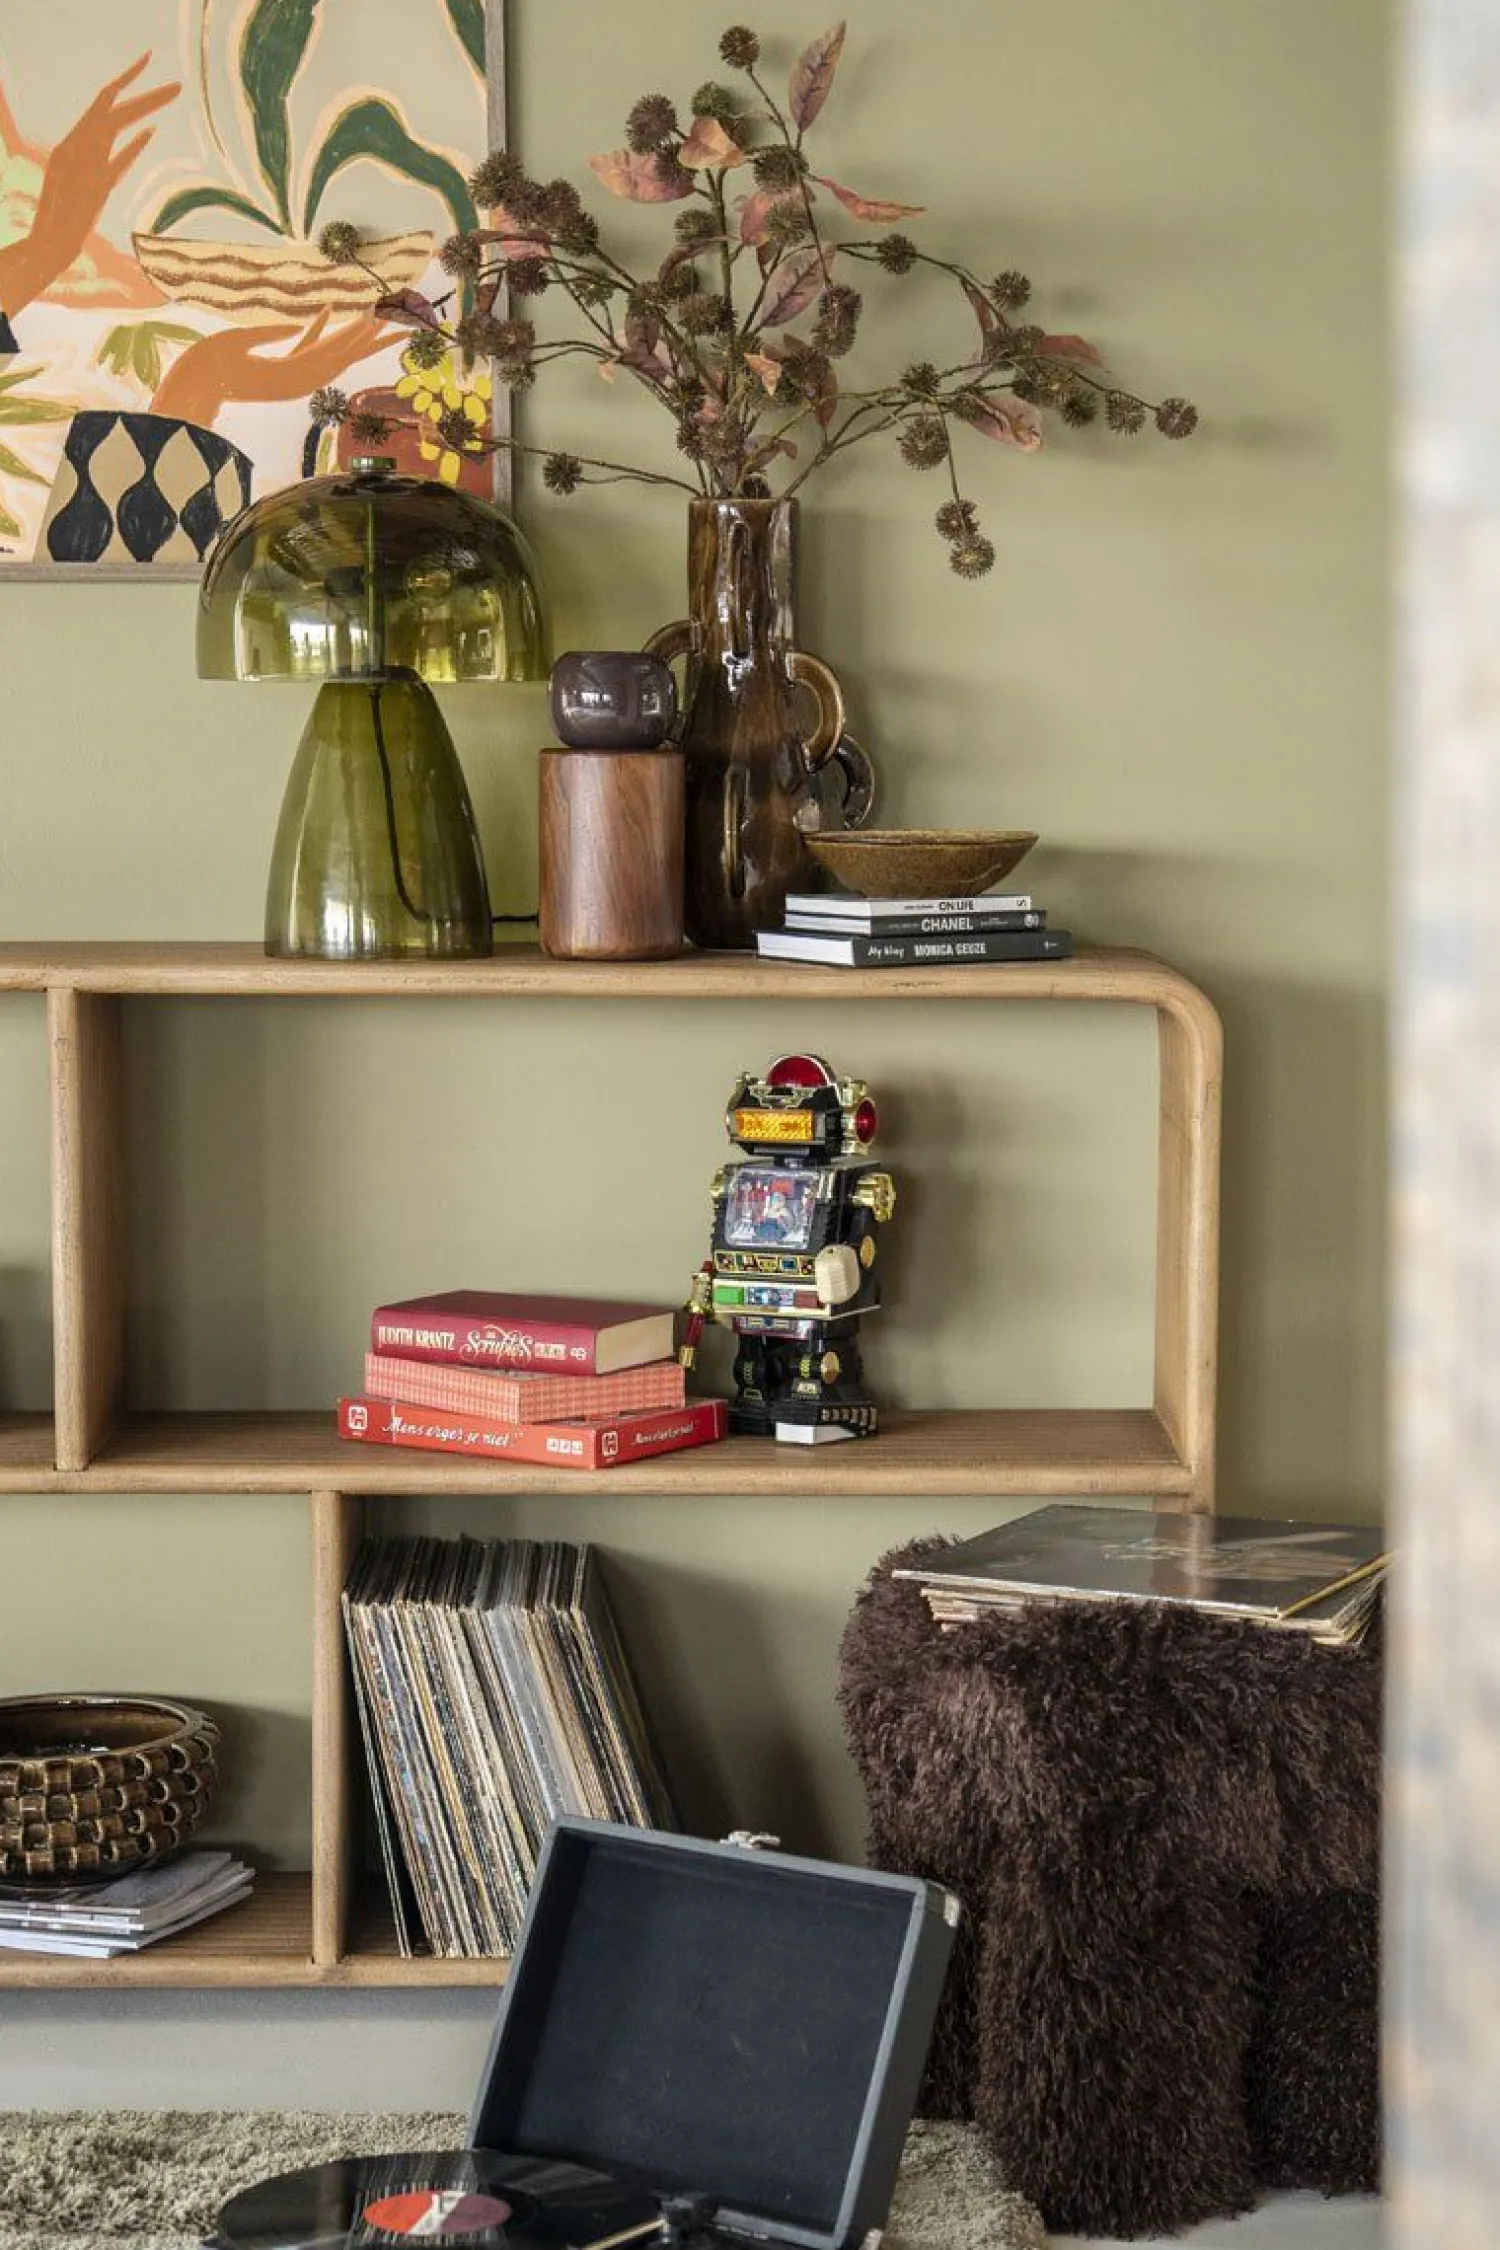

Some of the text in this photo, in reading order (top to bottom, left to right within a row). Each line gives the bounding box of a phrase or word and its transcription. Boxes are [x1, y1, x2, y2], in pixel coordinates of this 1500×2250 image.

[921, 917, 974, 932] CHANEL
[914, 943, 954, 957] MONICA
[378, 1326, 413, 1348] JUDITH
[415, 1329, 455, 1350] KRANTZ
